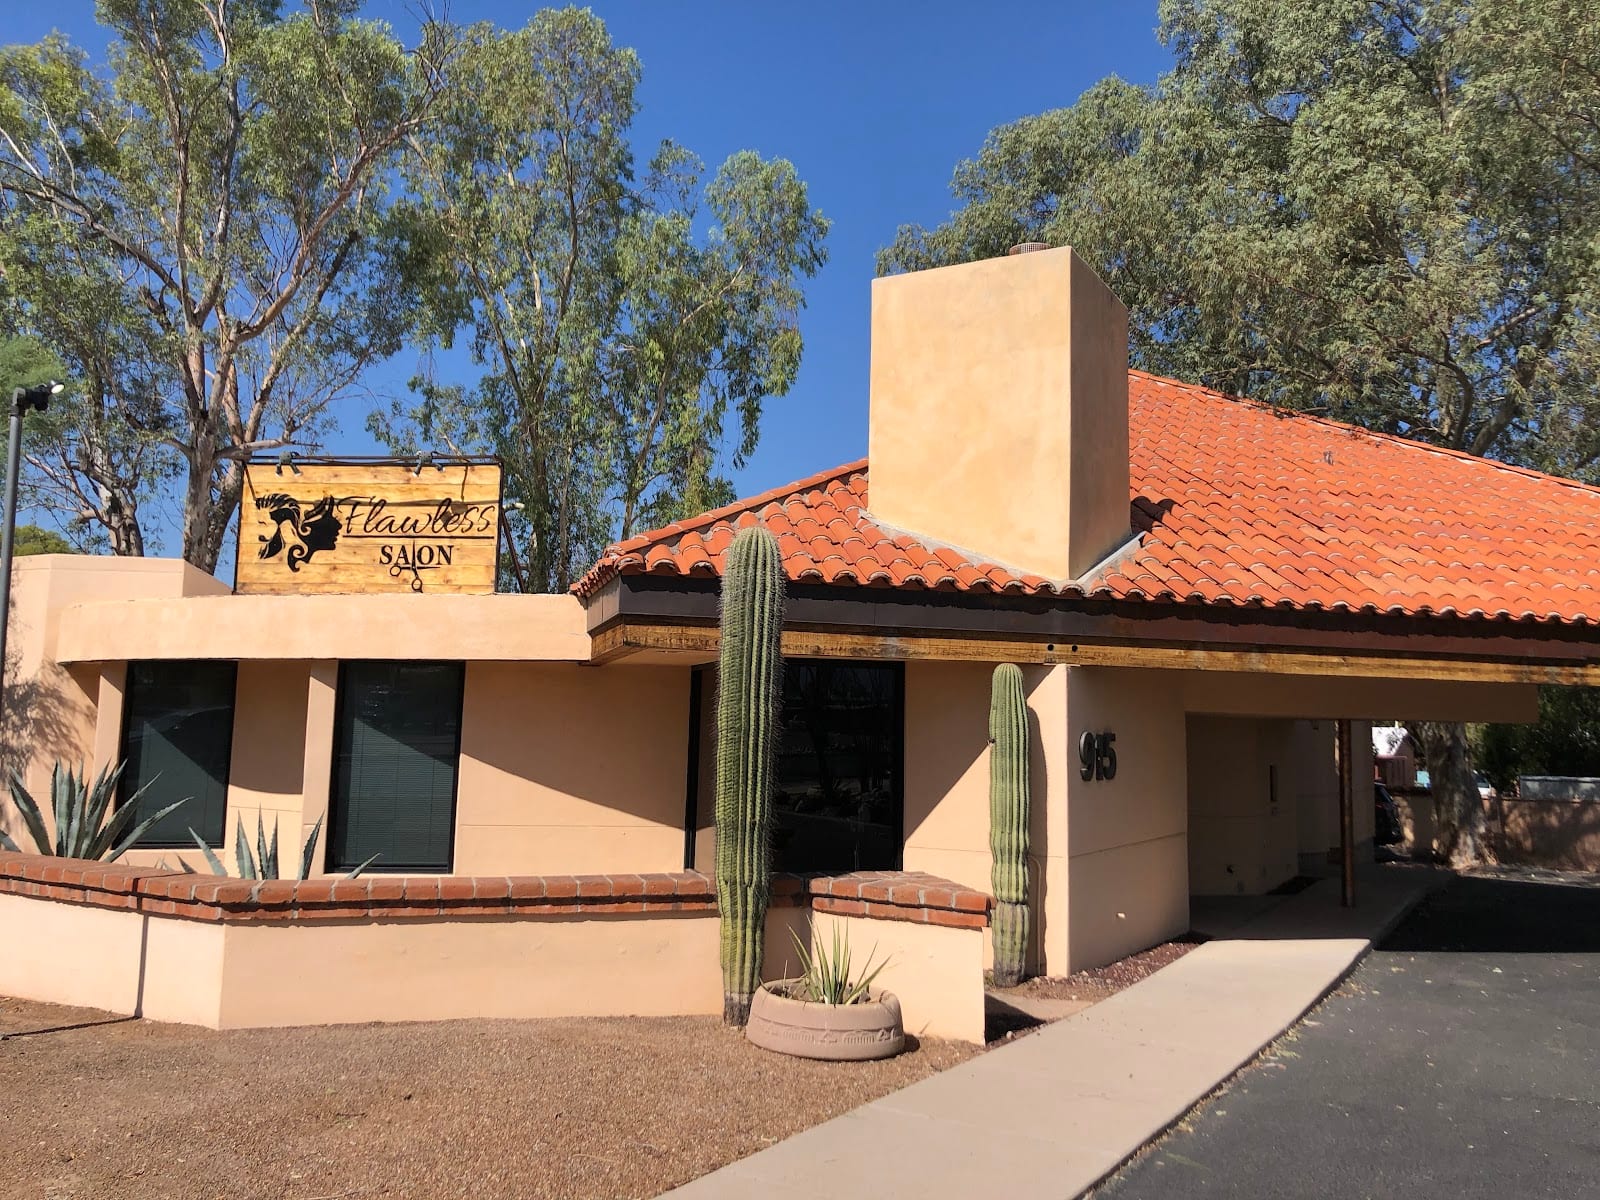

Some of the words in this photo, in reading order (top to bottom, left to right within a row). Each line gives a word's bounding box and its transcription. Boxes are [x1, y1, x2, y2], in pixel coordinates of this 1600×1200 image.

[336, 496, 496, 534] Flawless
[379, 541, 454, 570] SALON
[1079, 731, 1117, 781] 915
